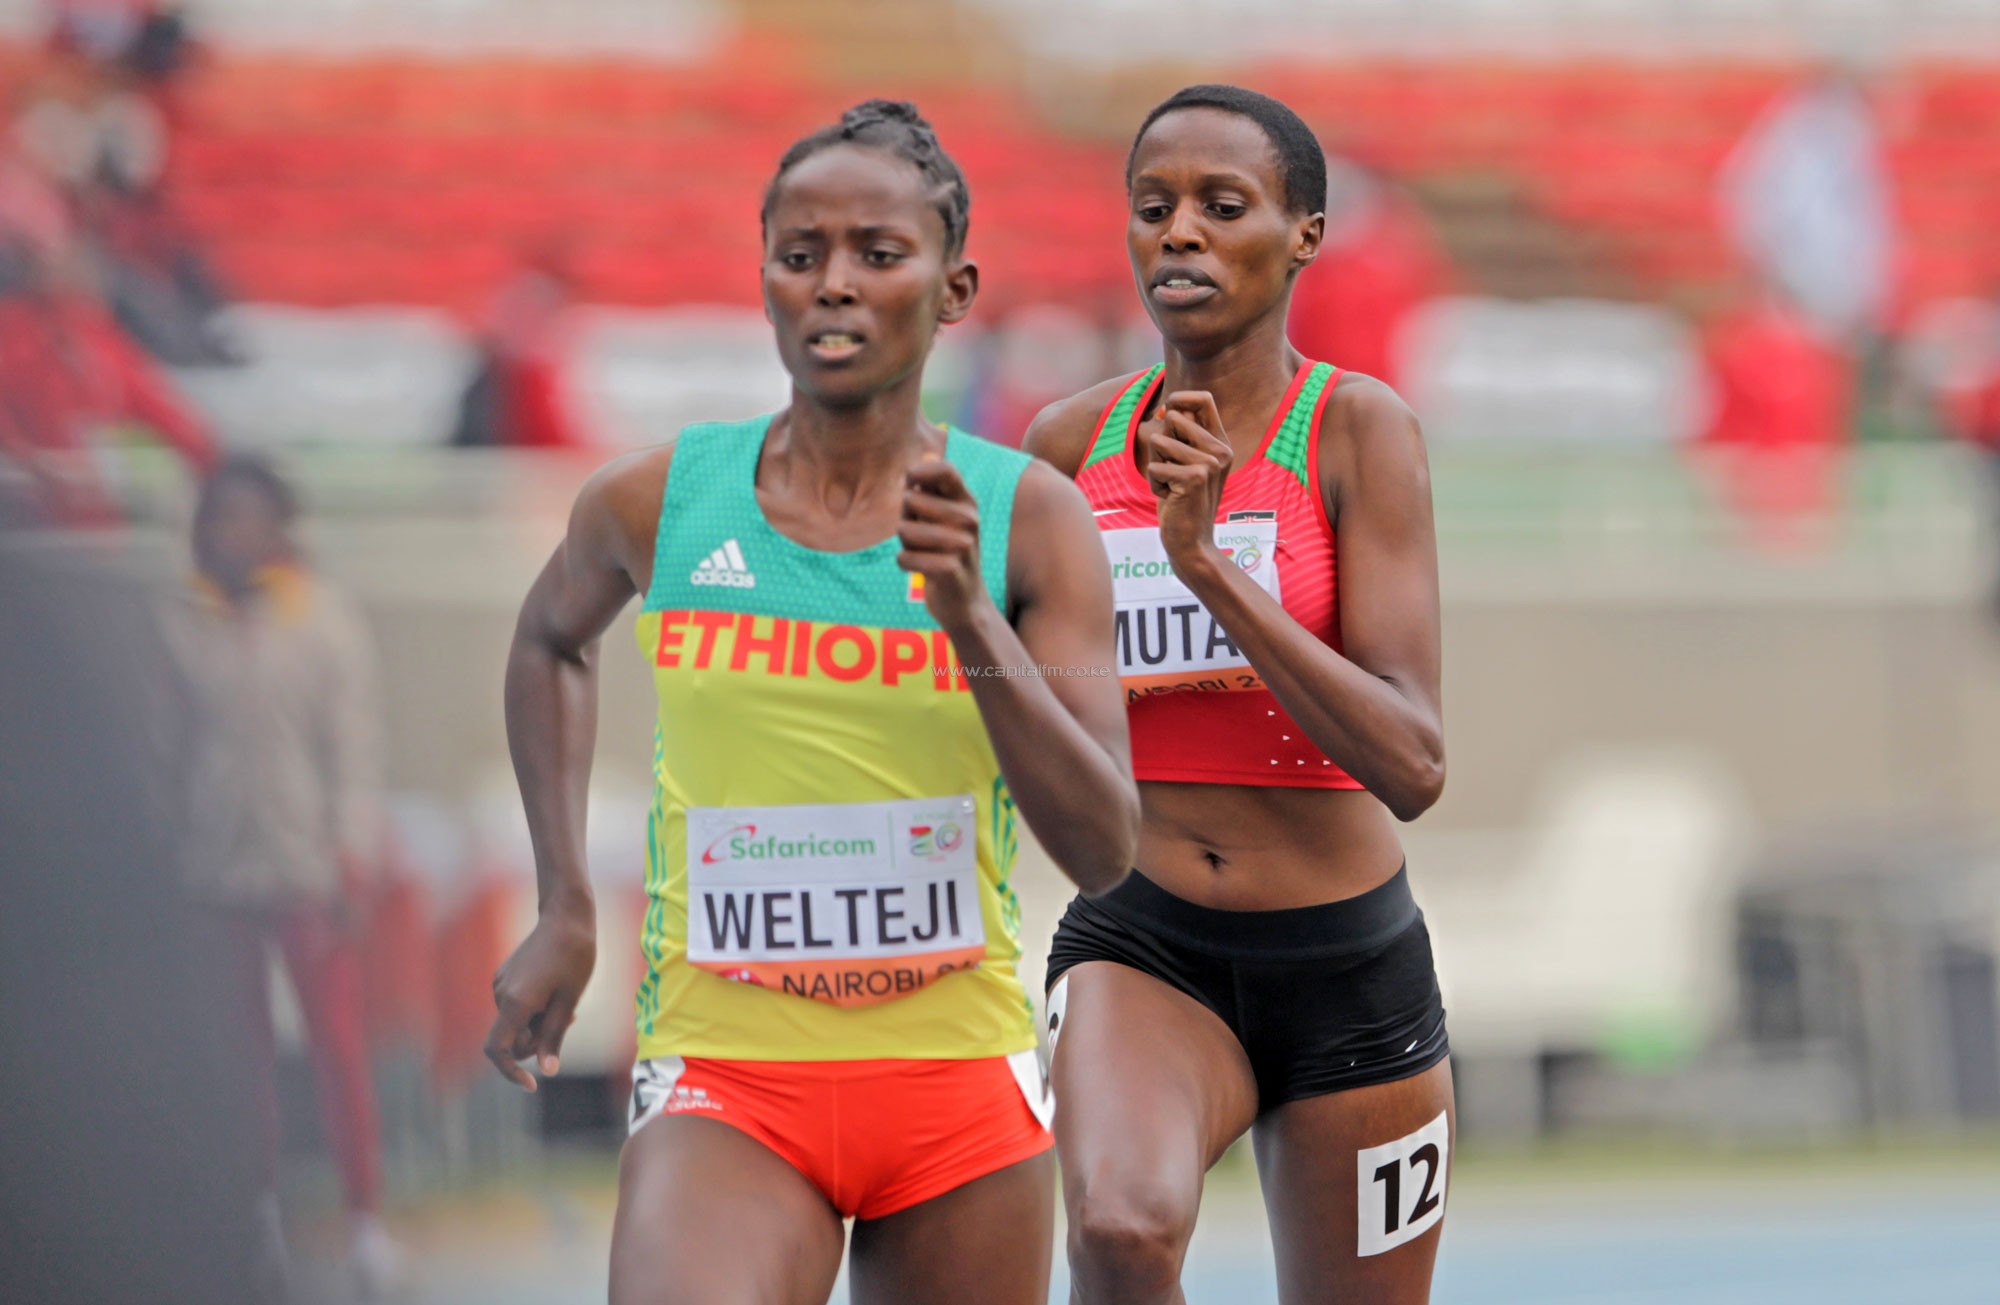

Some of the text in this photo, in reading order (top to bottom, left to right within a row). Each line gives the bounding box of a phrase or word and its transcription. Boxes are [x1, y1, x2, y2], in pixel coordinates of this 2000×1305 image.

[690, 569, 755, 588] adidas
[729, 833, 876, 860] Safaricom
[704, 880, 960, 950] WELTEJI
[782, 968, 924, 998] NAIROBI
[1373, 1143, 1440, 1235] 12
